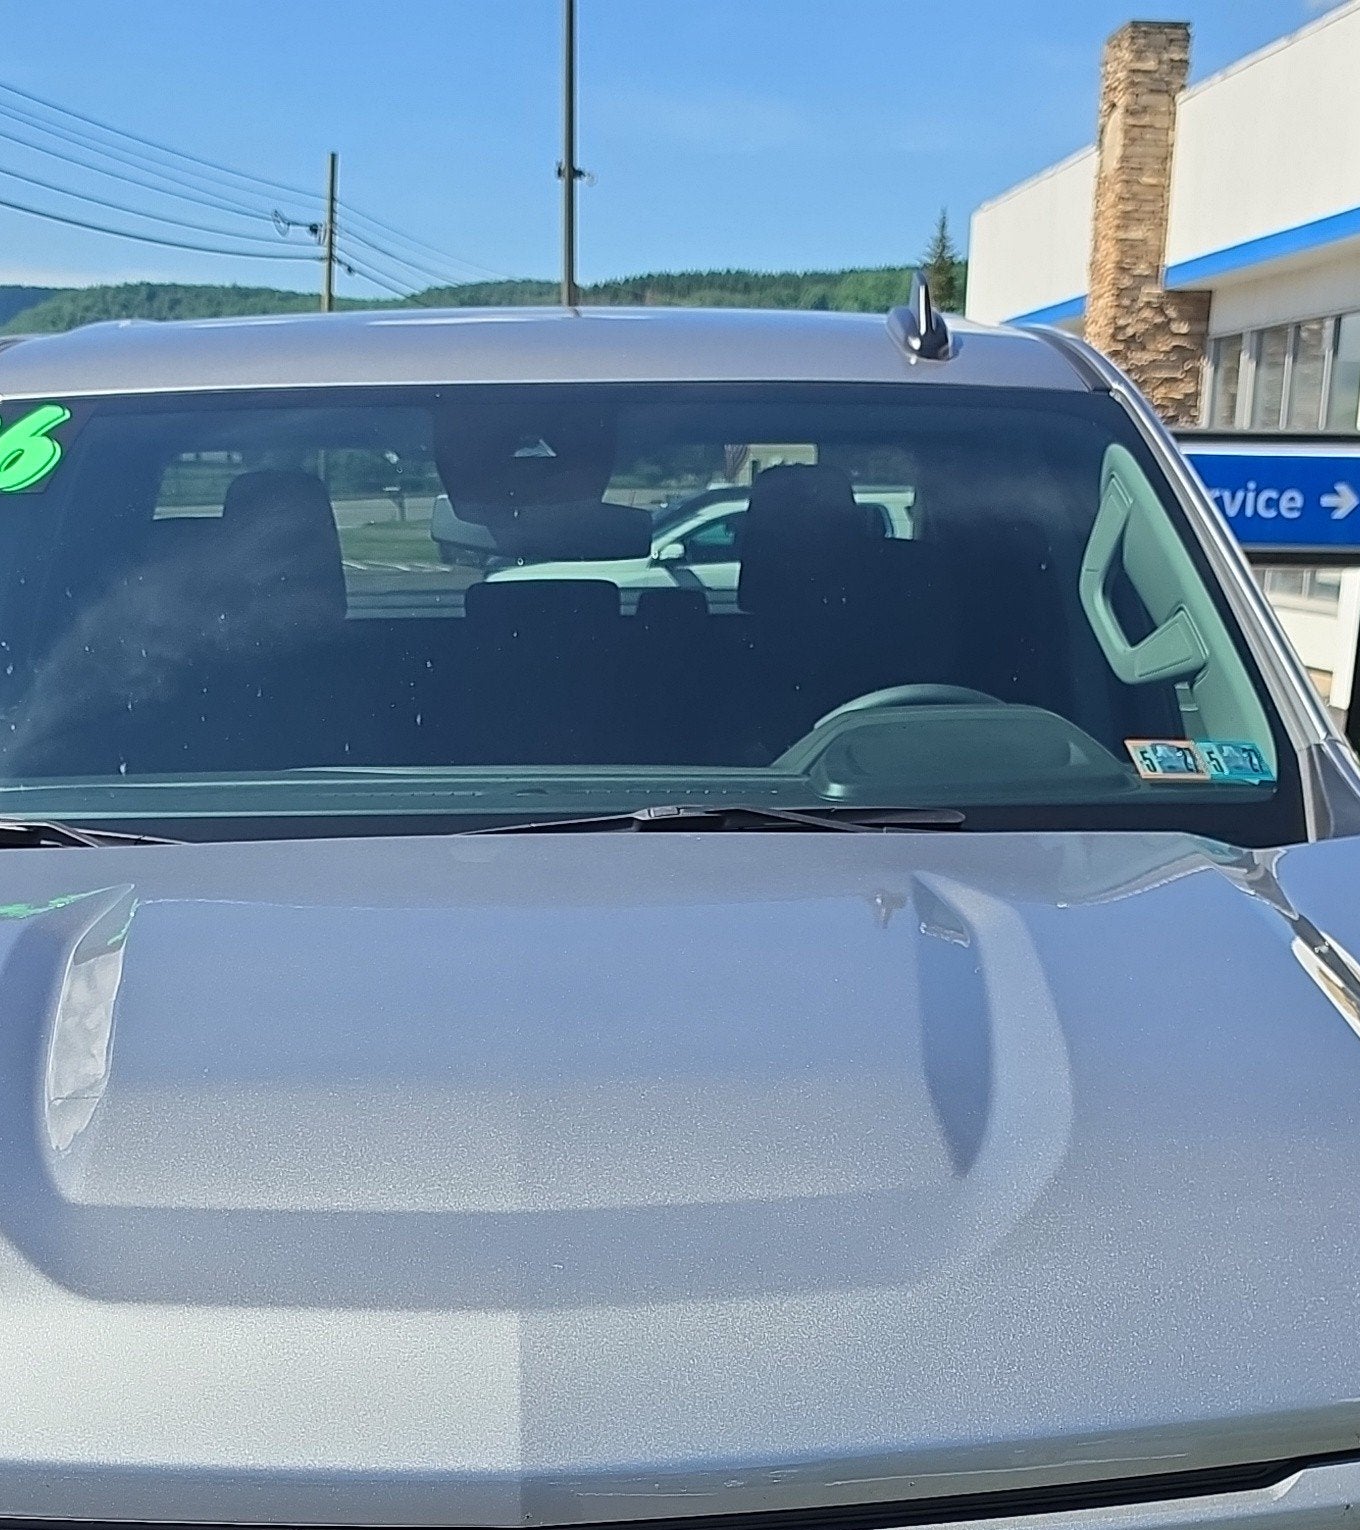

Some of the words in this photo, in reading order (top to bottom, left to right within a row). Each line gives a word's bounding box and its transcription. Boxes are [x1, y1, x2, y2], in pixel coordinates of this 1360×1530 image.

[1207, 480, 1305, 519] rvice
[1140, 750, 1157, 773] 5
[1206, 750, 1224, 773] 5
